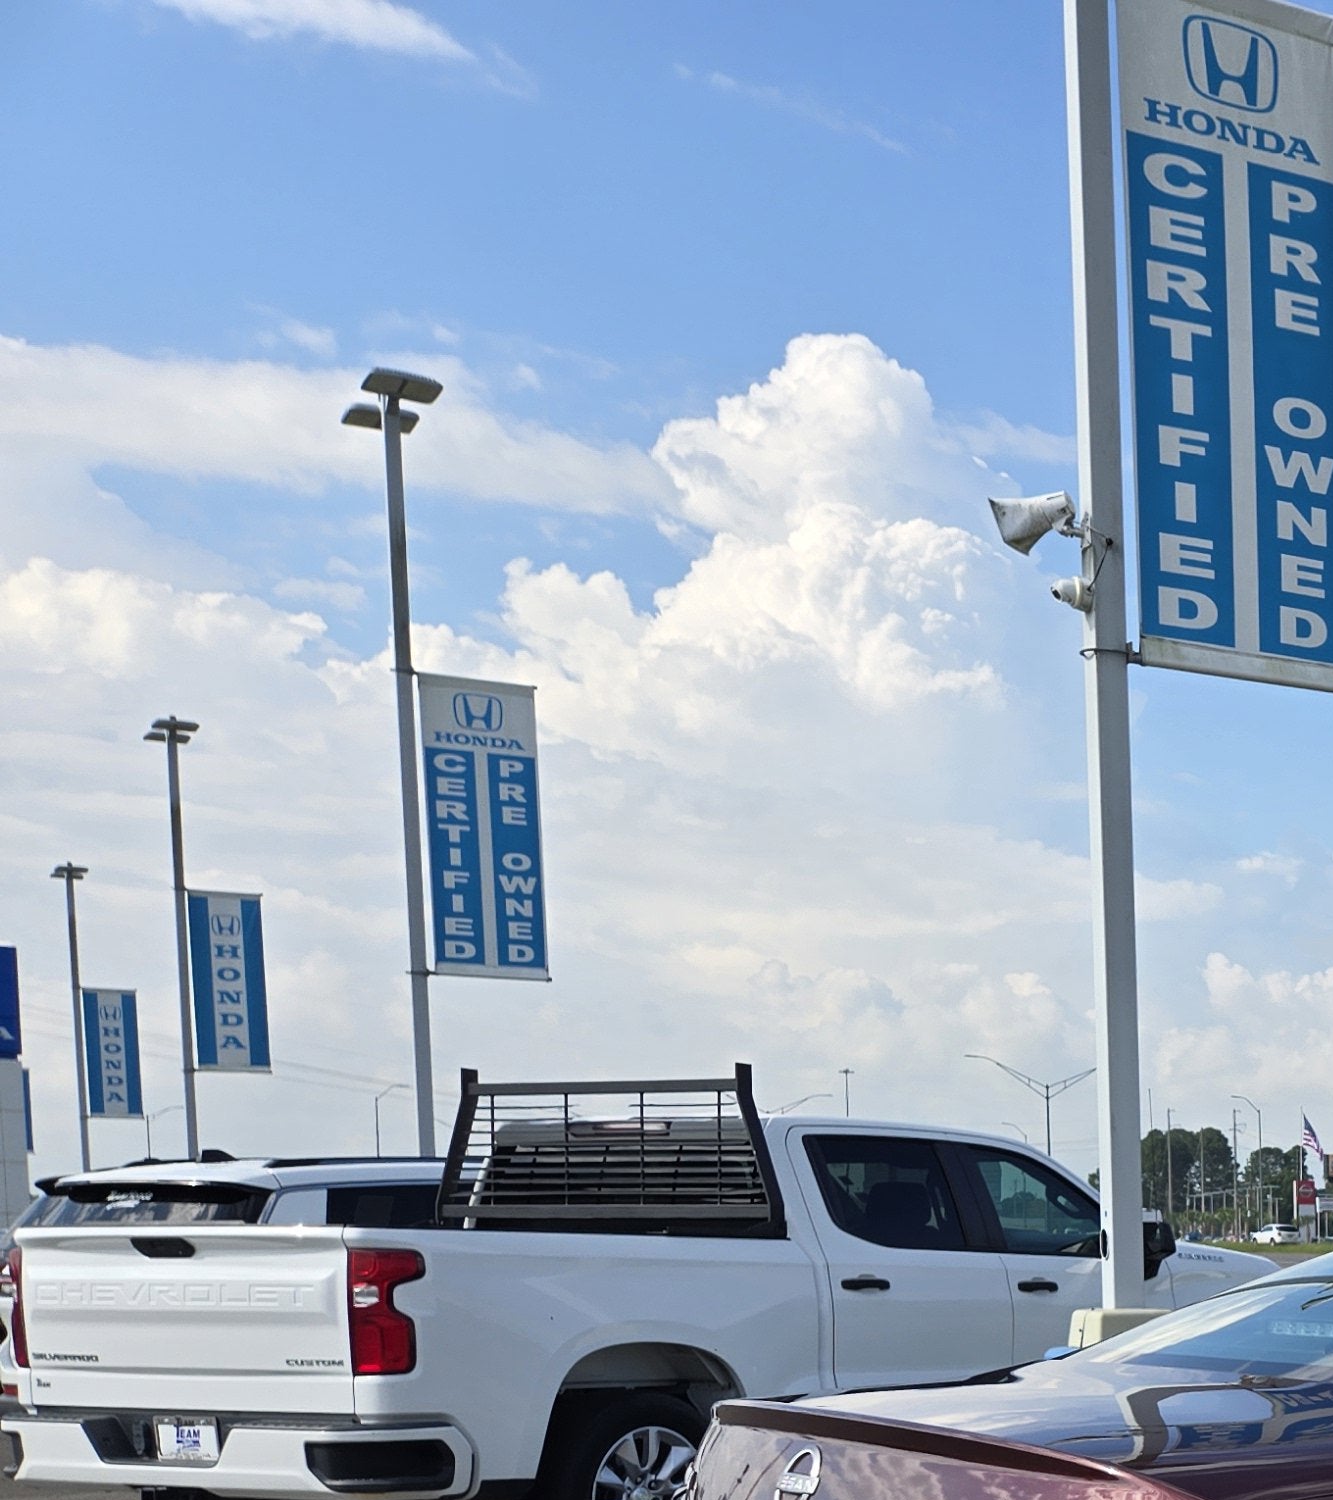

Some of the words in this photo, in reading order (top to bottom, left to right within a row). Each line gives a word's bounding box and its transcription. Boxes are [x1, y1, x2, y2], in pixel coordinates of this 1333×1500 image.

[1143, 97, 1321, 167] HONDA
[1269, 179, 1322, 338] PRE
[1142, 151, 1219, 631] CERTIFIED
[433, 730, 525, 752] HONDA
[499, 759, 527, 827] PRE
[432, 752, 477, 961] CERTIFIED
[499, 852, 537, 964] OWNED
[213, 944, 247, 1051] HONDA
[101, 1026, 125, 1103] HONDA
[34, 1282, 315, 1308] CHEVROLET
[285, 1359, 344, 1367] CUSTOM
[173, 1424, 200, 1438] TEAM
